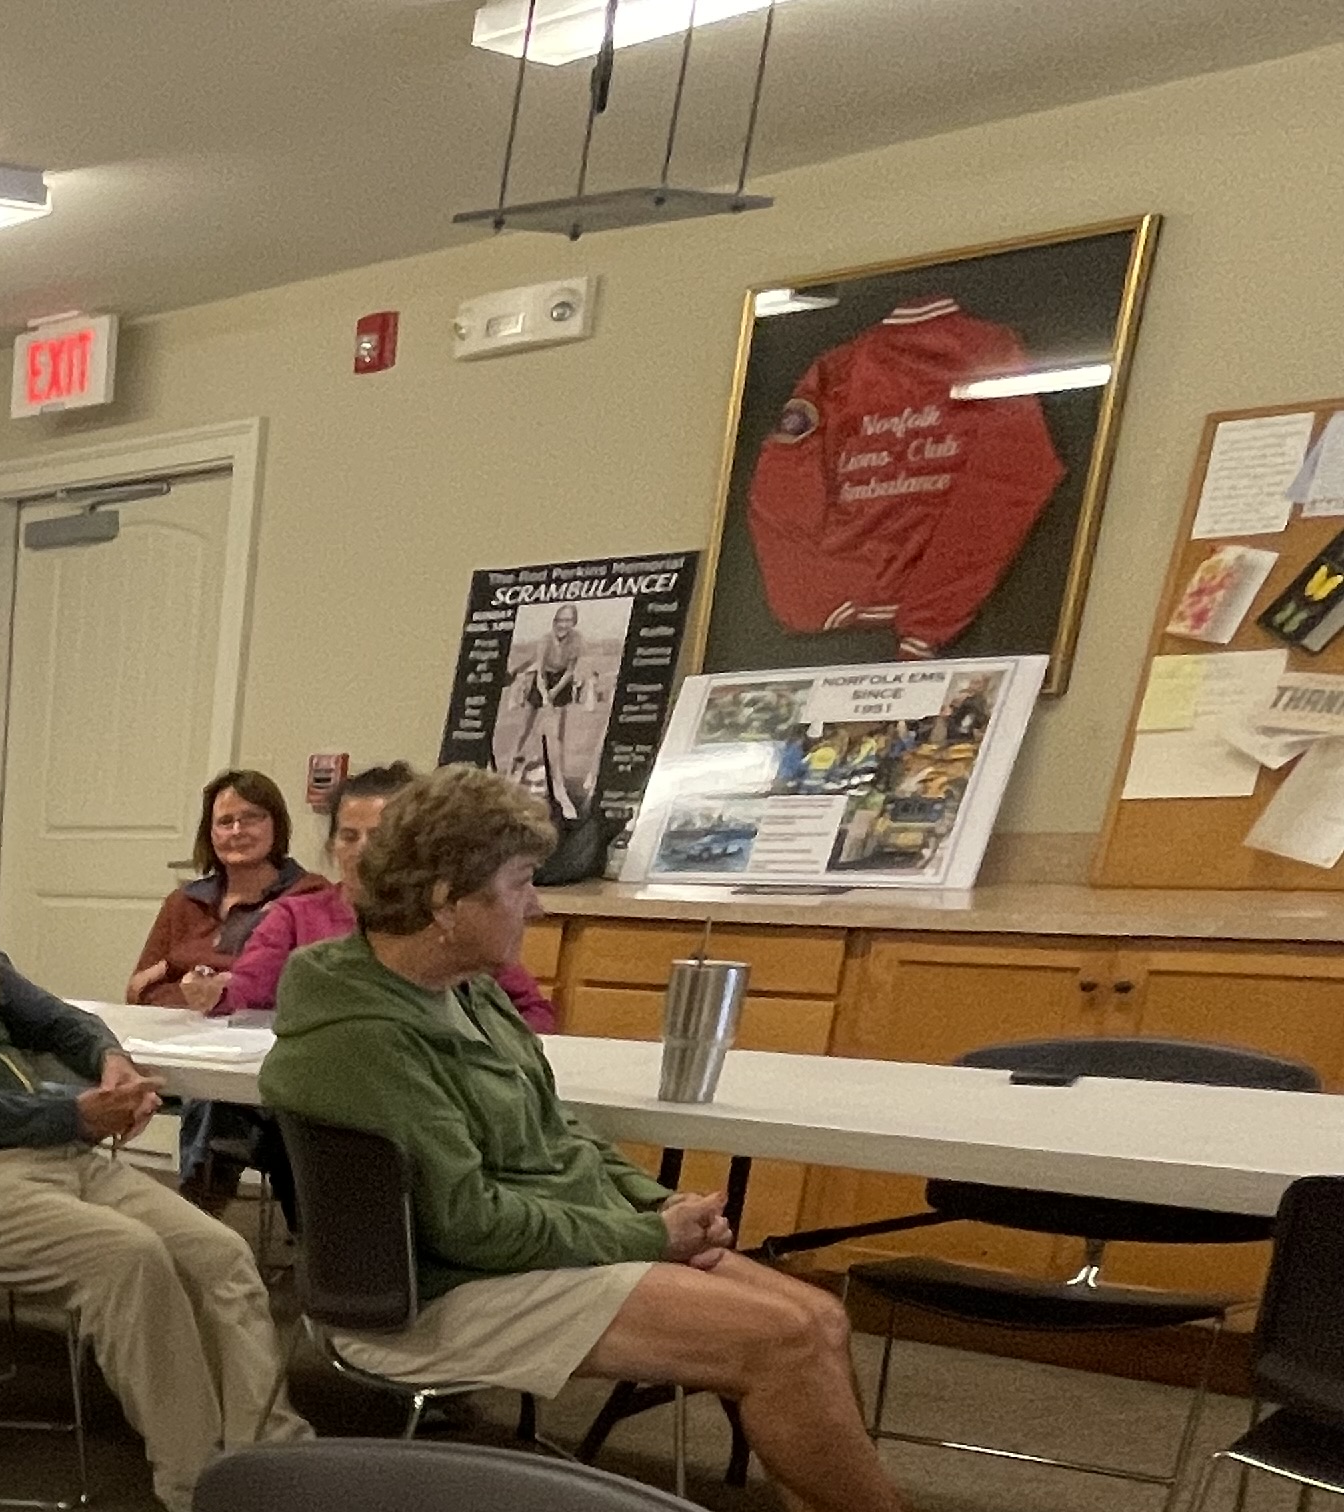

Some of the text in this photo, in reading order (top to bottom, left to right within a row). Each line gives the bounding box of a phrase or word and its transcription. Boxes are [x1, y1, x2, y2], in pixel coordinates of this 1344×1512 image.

[27, 330, 96, 404] EXIT
[863, 405, 941, 437] Norfolk
[907, 435, 959, 461] Club
[490, 572, 679, 607] SCRAMBULANCE!
[821, 673, 904, 687] NORFOLK
